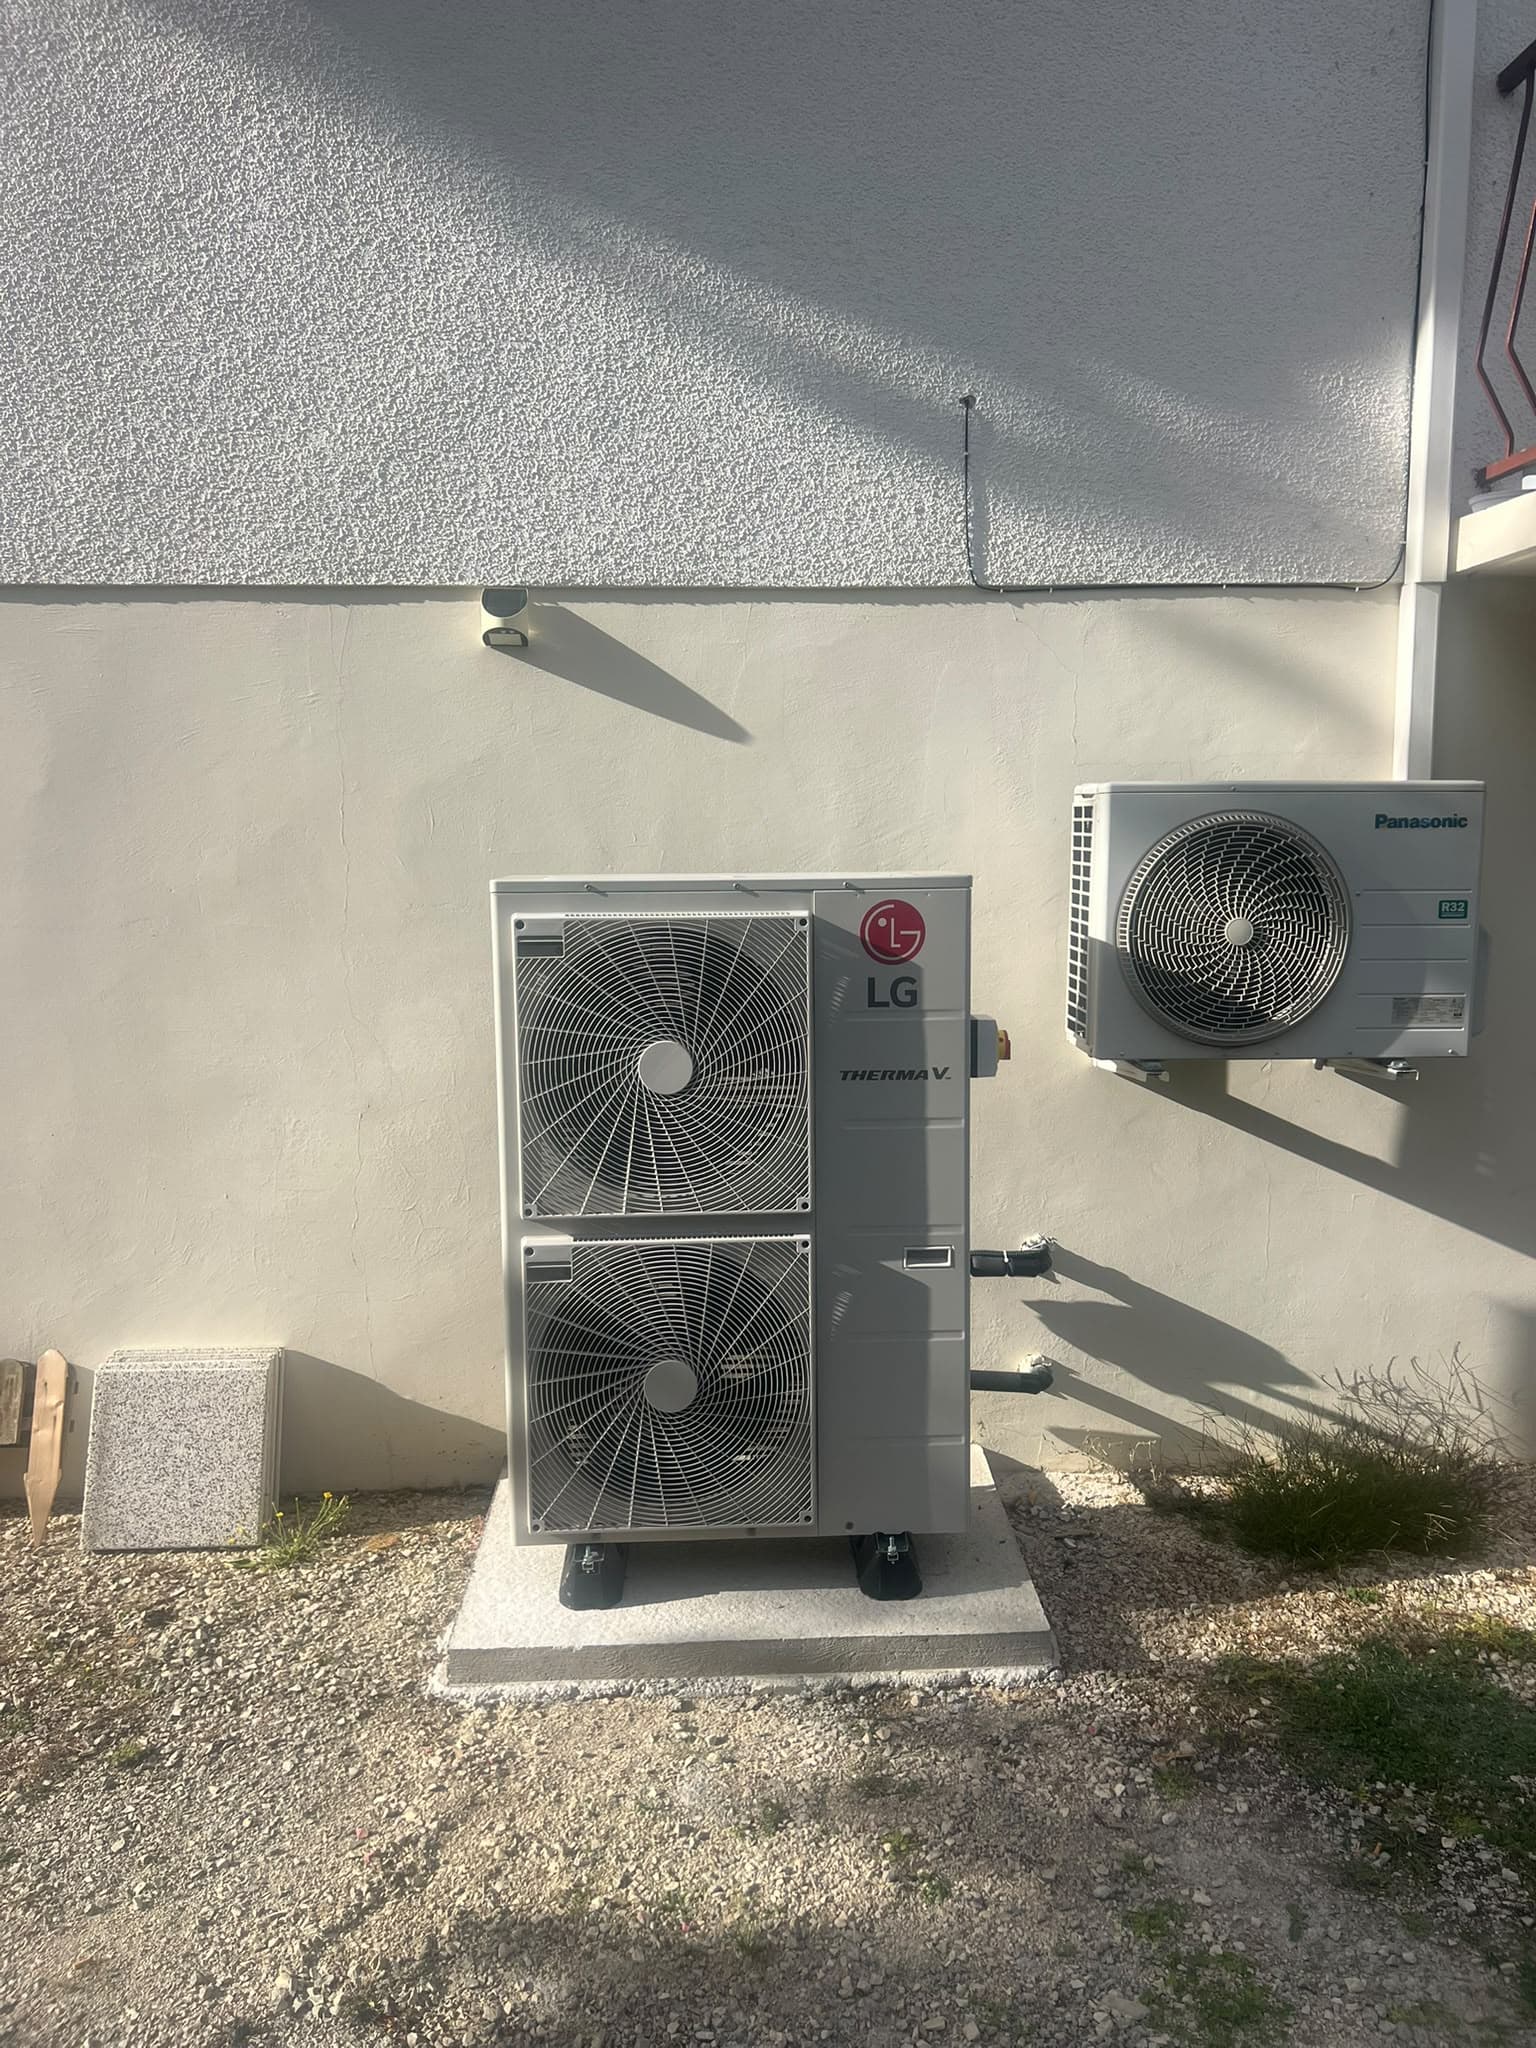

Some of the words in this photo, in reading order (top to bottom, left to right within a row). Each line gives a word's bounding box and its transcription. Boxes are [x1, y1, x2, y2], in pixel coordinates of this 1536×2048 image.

[1375, 813, 1468, 829] Panasonic
[1441, 902, 1465, 911] R32
[867, 976, 918, 1008] LG
[840, 1069, 929, 1081] THERMA
